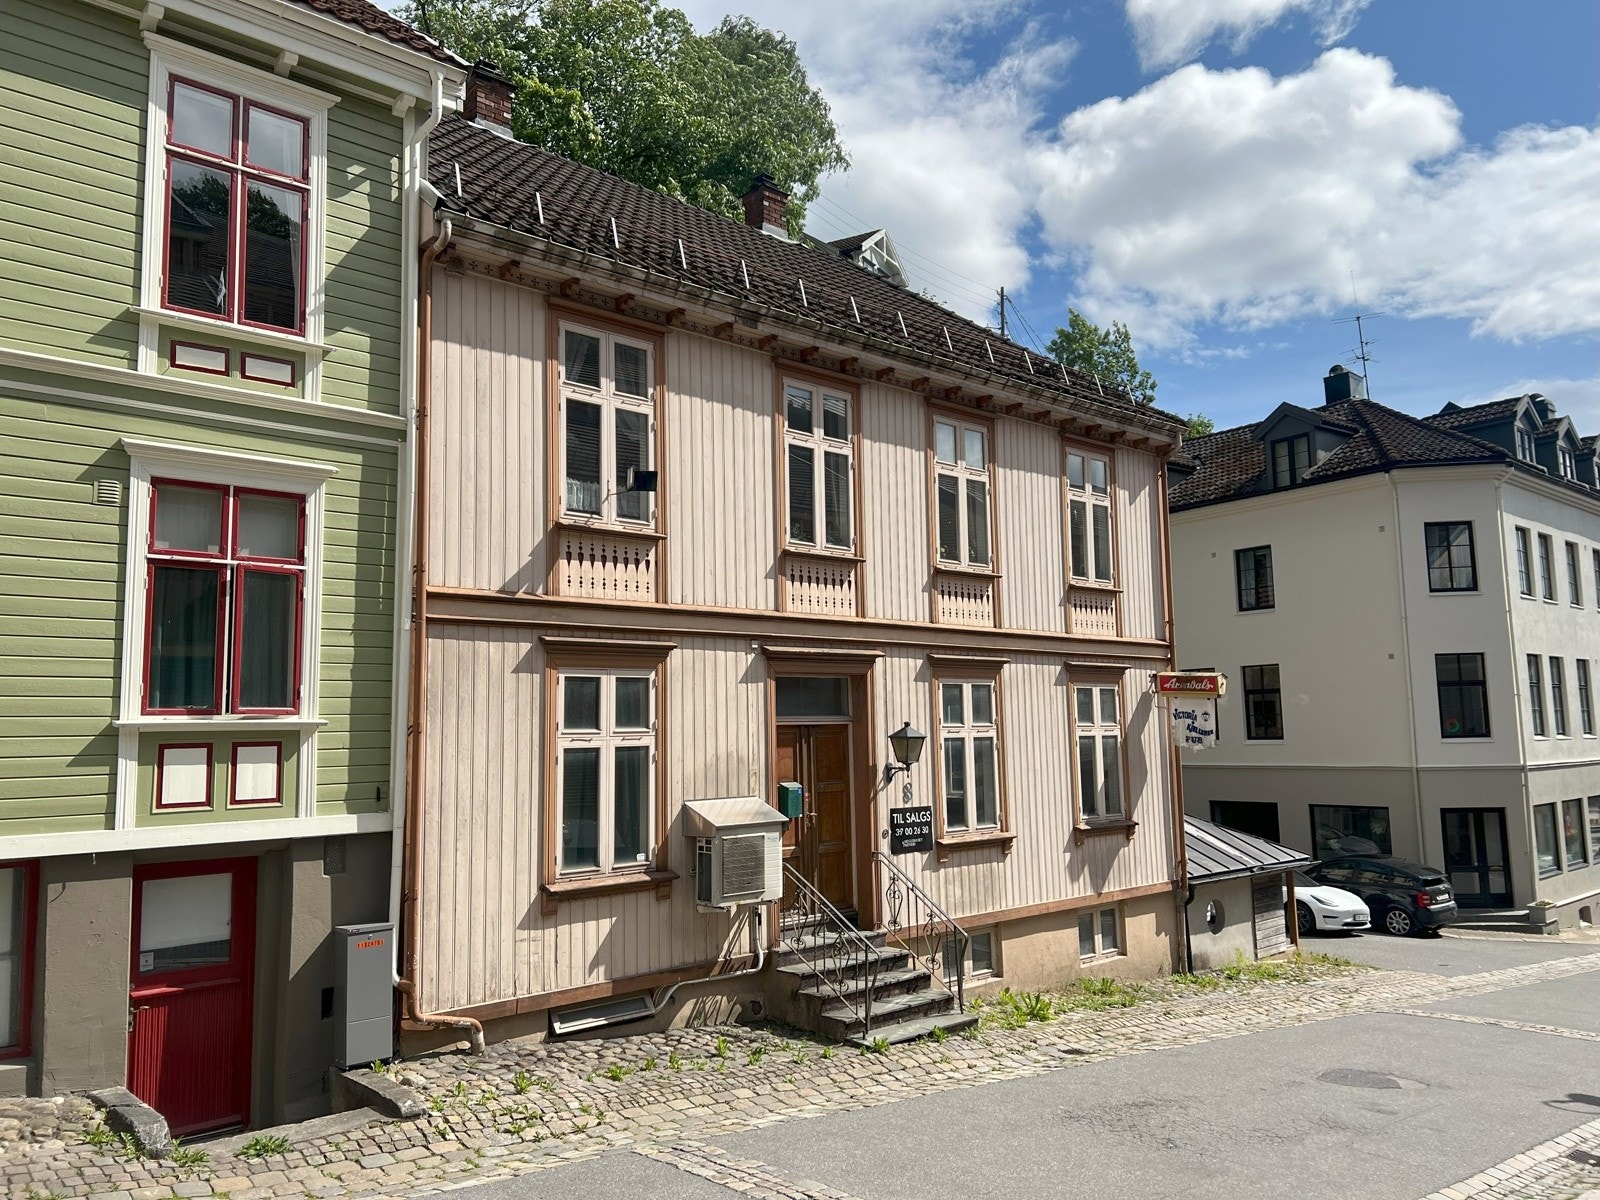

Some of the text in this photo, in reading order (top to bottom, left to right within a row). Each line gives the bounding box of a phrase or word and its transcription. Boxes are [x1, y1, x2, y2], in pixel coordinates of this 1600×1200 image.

[1185, 736, 1203, 744] PUB
[902, 782, 913, 804] 8
[893, 811, 931, 824] TIL SALGS
[895, 828, 903, 837] 37
[904, 827, 913, 836] 00
[921, 825, 929, 834] 30
